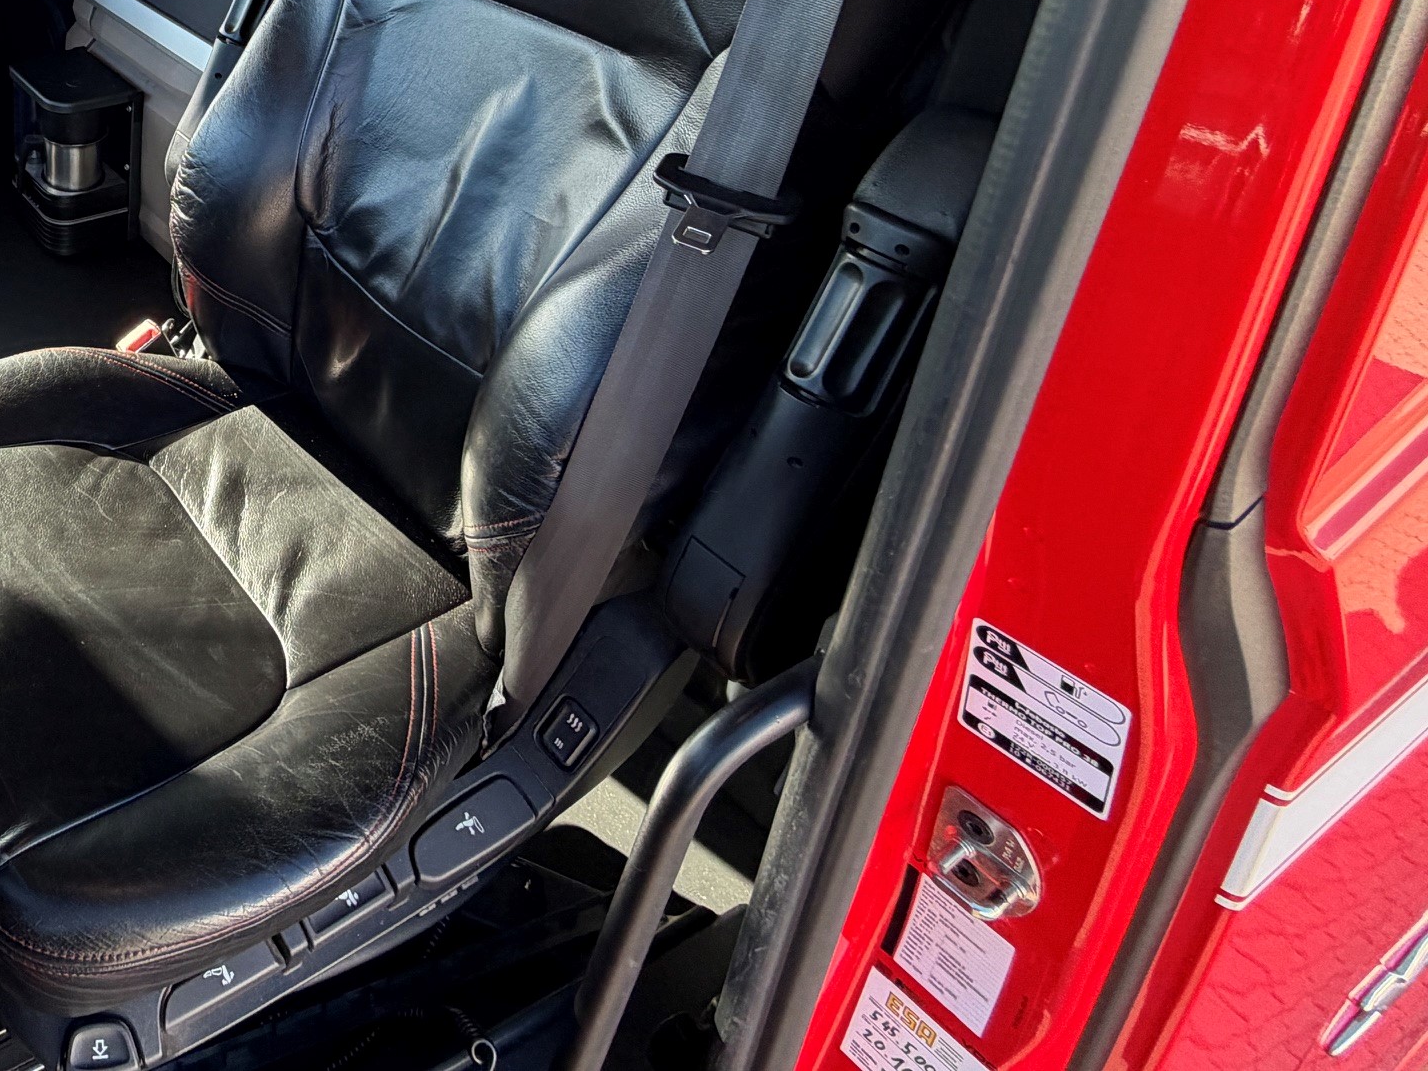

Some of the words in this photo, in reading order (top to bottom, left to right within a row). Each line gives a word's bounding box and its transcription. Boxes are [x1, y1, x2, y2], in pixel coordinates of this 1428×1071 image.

[980, 686, 1026, 721] THERMO
[1027, 717, 1053, 738] TOP
[1054, 735, 1080, 756] PRO
[1013, 731, 1023, 742] 24
[1027, 740, 1034, 749] V
[1014, 701, 1065, 739] Webasto
[1015, 718, 1043, 741] Diesel
[1014, 725, 1037, 744] max.
[1059, 754, 1076, 770] bar
[885, 990, 938, 1048] ESA
